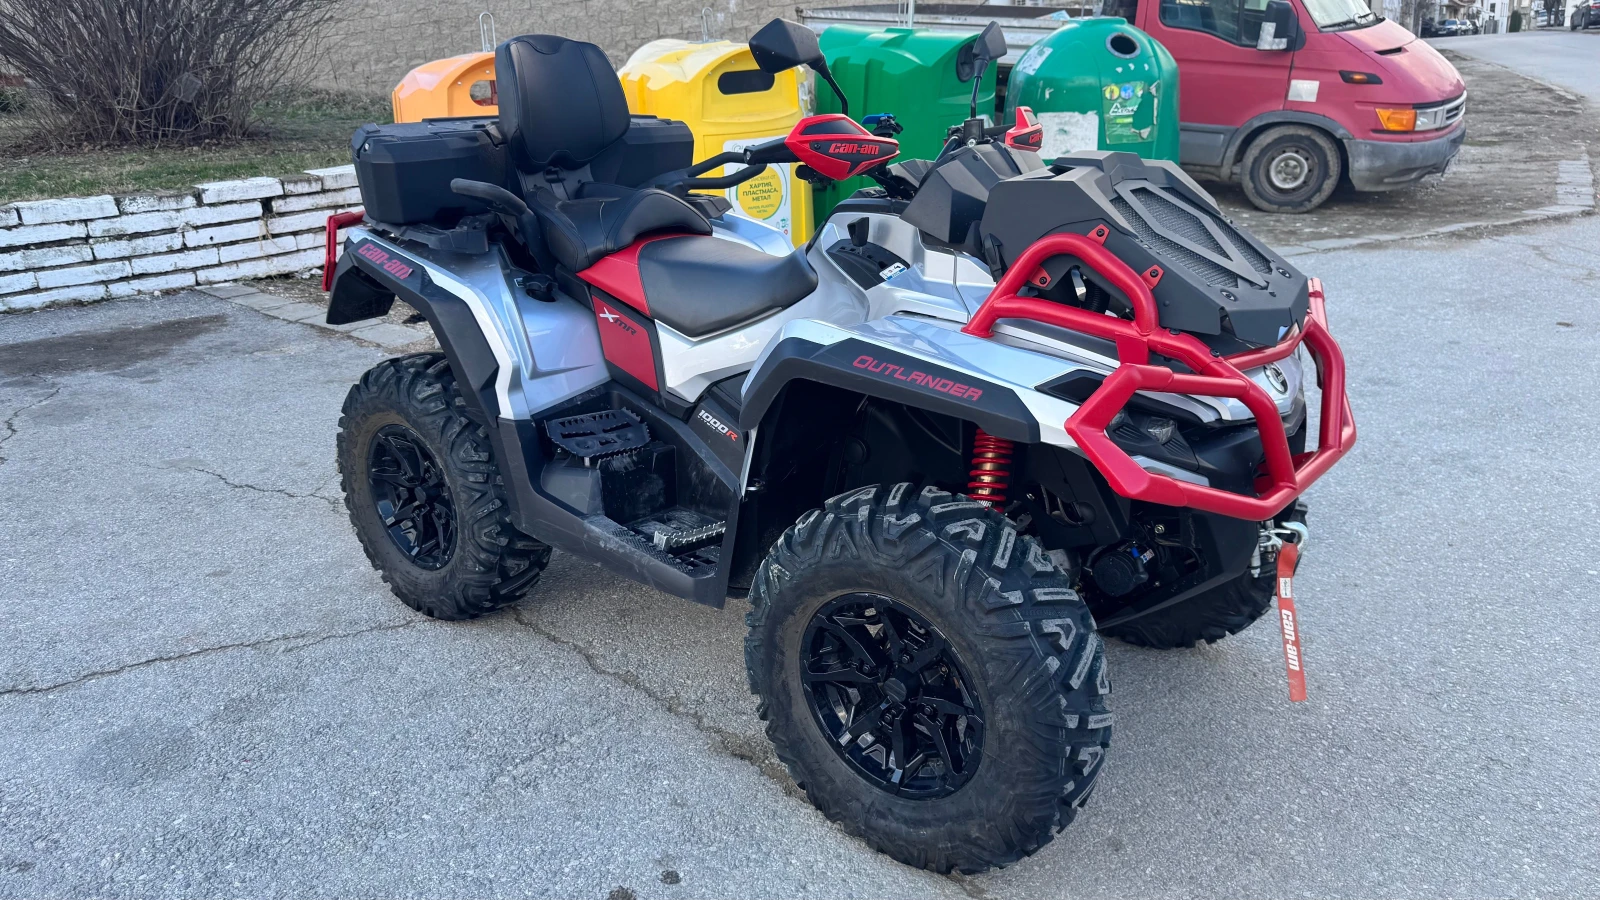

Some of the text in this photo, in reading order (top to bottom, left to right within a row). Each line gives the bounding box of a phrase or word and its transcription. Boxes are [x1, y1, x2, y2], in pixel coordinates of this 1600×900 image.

[742, 187, 778, 196] ПЛАСТМАСА,
[752, 194, 771, 202] МЕТАЛ
[852, 355, 983, 402] OUTLANDER
[699, 409, 738, 442] 1000R
